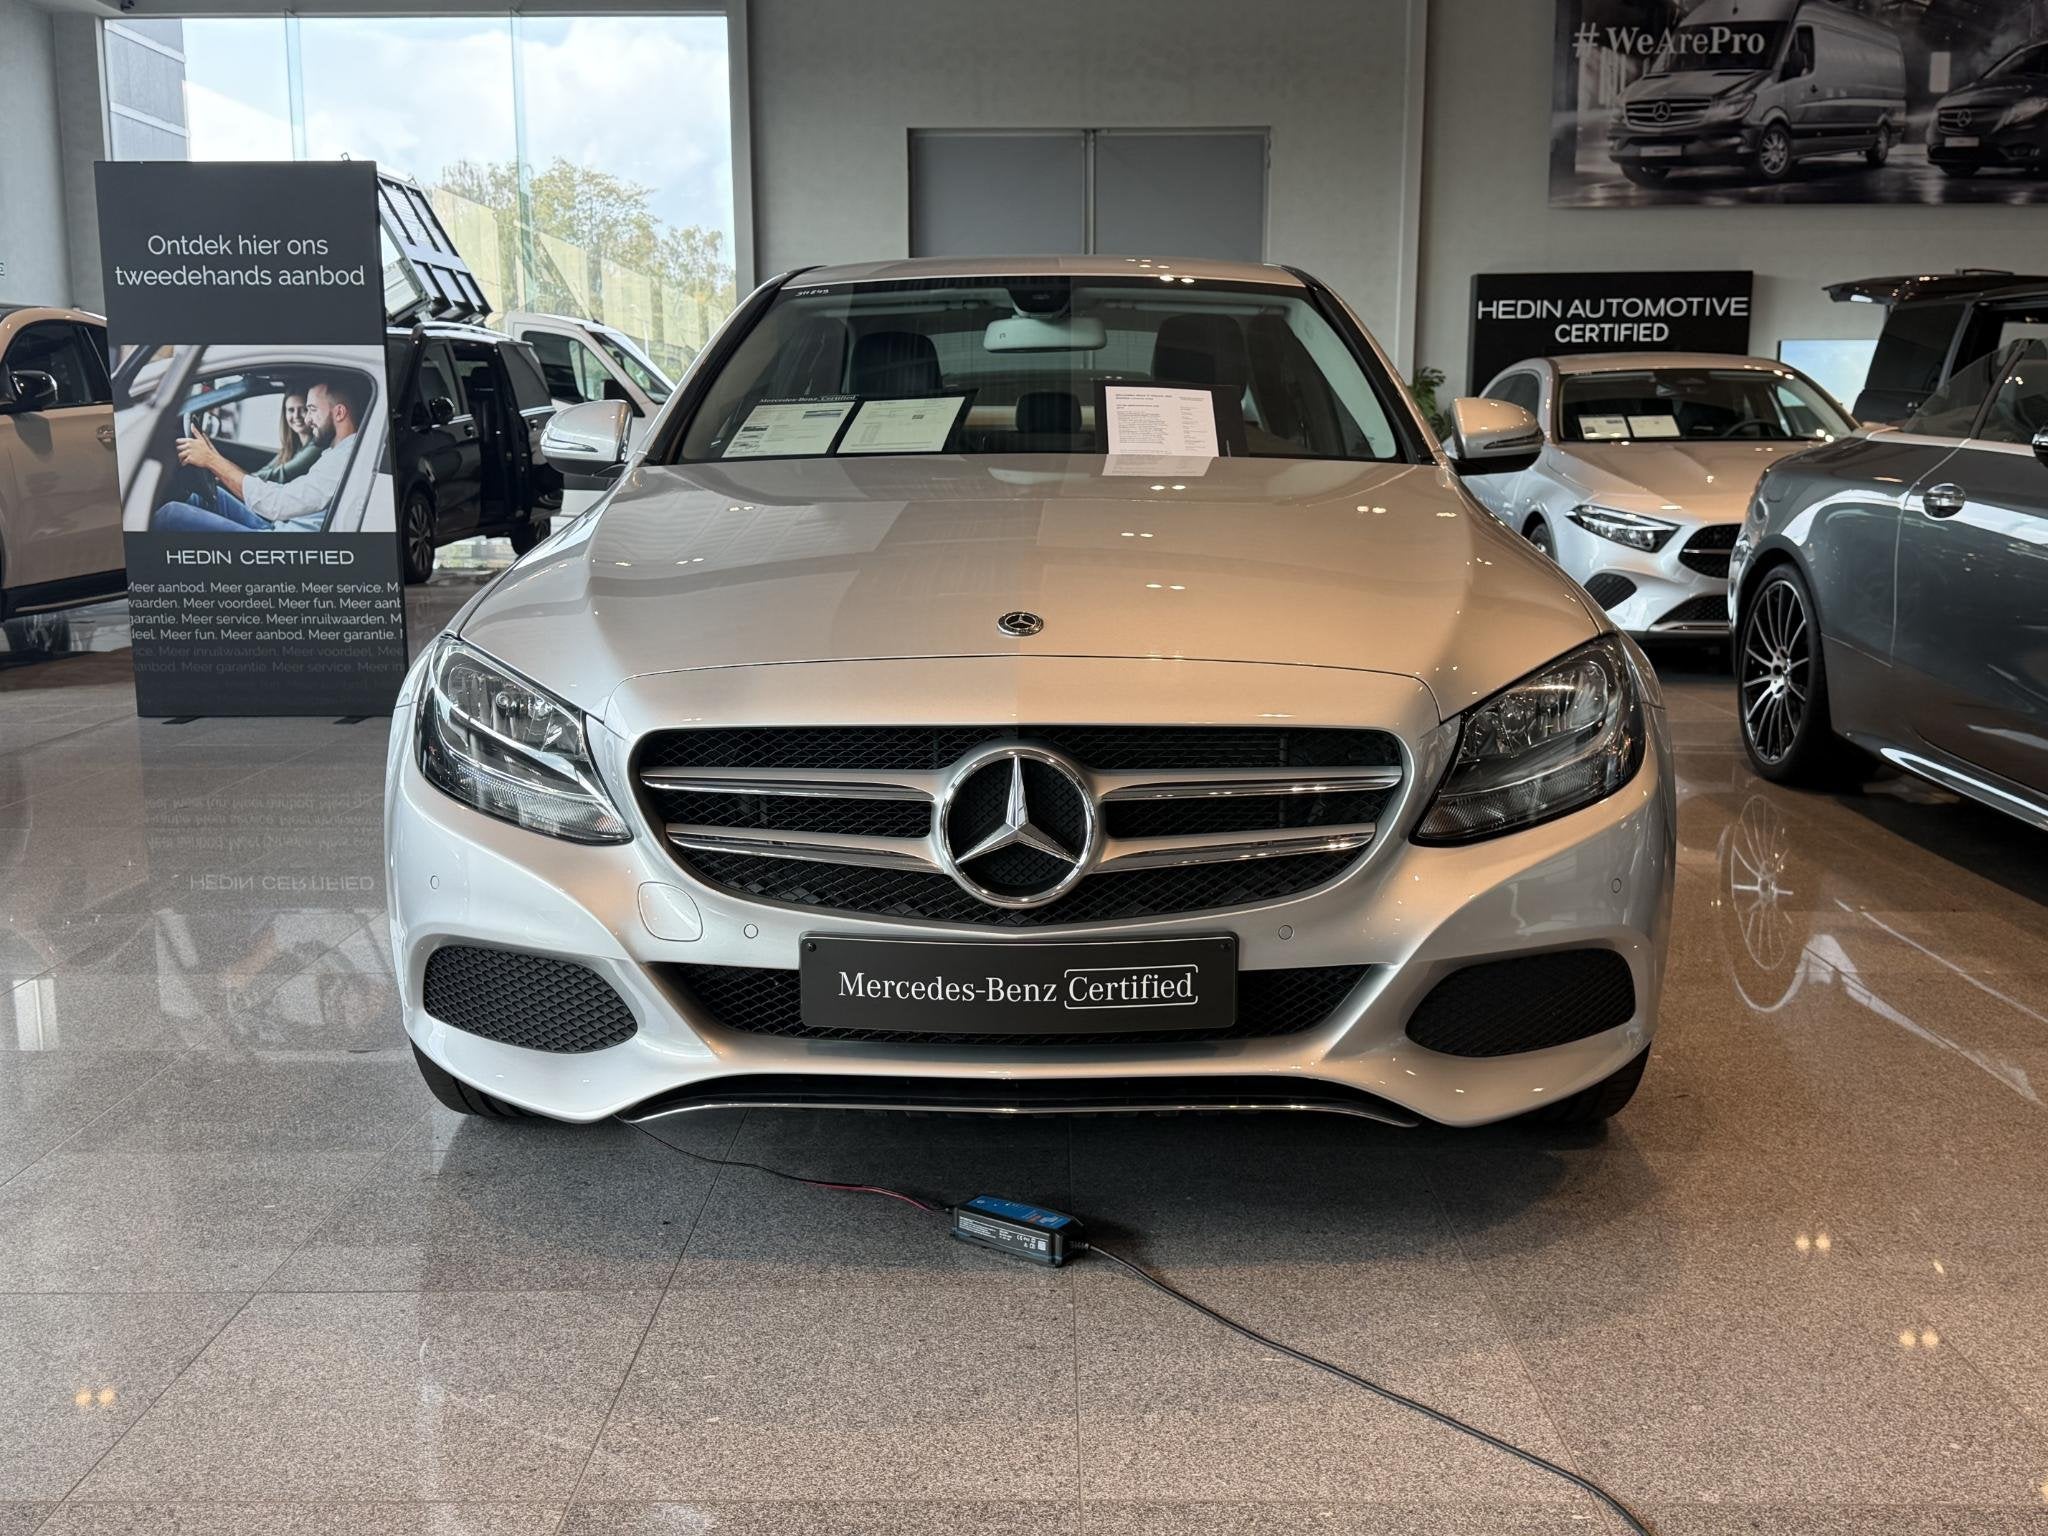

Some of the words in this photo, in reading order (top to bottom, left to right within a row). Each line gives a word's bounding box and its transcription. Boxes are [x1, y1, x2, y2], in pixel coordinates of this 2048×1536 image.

[147, 235, 232, 255] Ontdek
[238, 235, 281, 255] hier
[287, 238, 328, 255] ons
[115, 266, 272, 286] tweedehands
[278, 266, 365, 286] aanbod
[1478, 299, 1562, 320] HEDIN
[1568, 297, 1749, 318] AUTOMOTIVE
[1555, 323, 1669, 342] CERTIFIED
[166, 550, 232, 565] HEDIN
[240, 550, 355, 565] CERTIFIED
[157, 582, 207, 593] aanbod.
[210, 582, 242, 593] Meer
[245, 582, 298, 596] garantie.
[302, 582, 334, 593] Meer
[336, 582, 384, 593] service.
[183, 598, 215, 609] Meer
[218, 598, 276, 609] voordeel.
[279, 598, 311, 609] Meer
[313, 598, 336, 609] fun.
[340, 598, 372, 609] Meer
[181, 613, 214, 625] Meer
[216, 613, 263, 625] service.
[266, 613, 299, 625] Meer
[301, 613, 387, 625] inruilwaarden.
[160, 629, 192, 641] Meer
[195, 629, 218, 641] fun.
[221, 629, 254, 641] Meer
[256, 629, 305, 641] aanbod.
[308, 629, 341, 641] Meer
[343, 629, 396, 643] garantie.
[159, 646, 190, 657] Meer
[282, 646, 314, 657] Meer
[838, 971, 1057, 1003] Mercedes-Benz
[1068, 972, 1192, 1002] Certified
